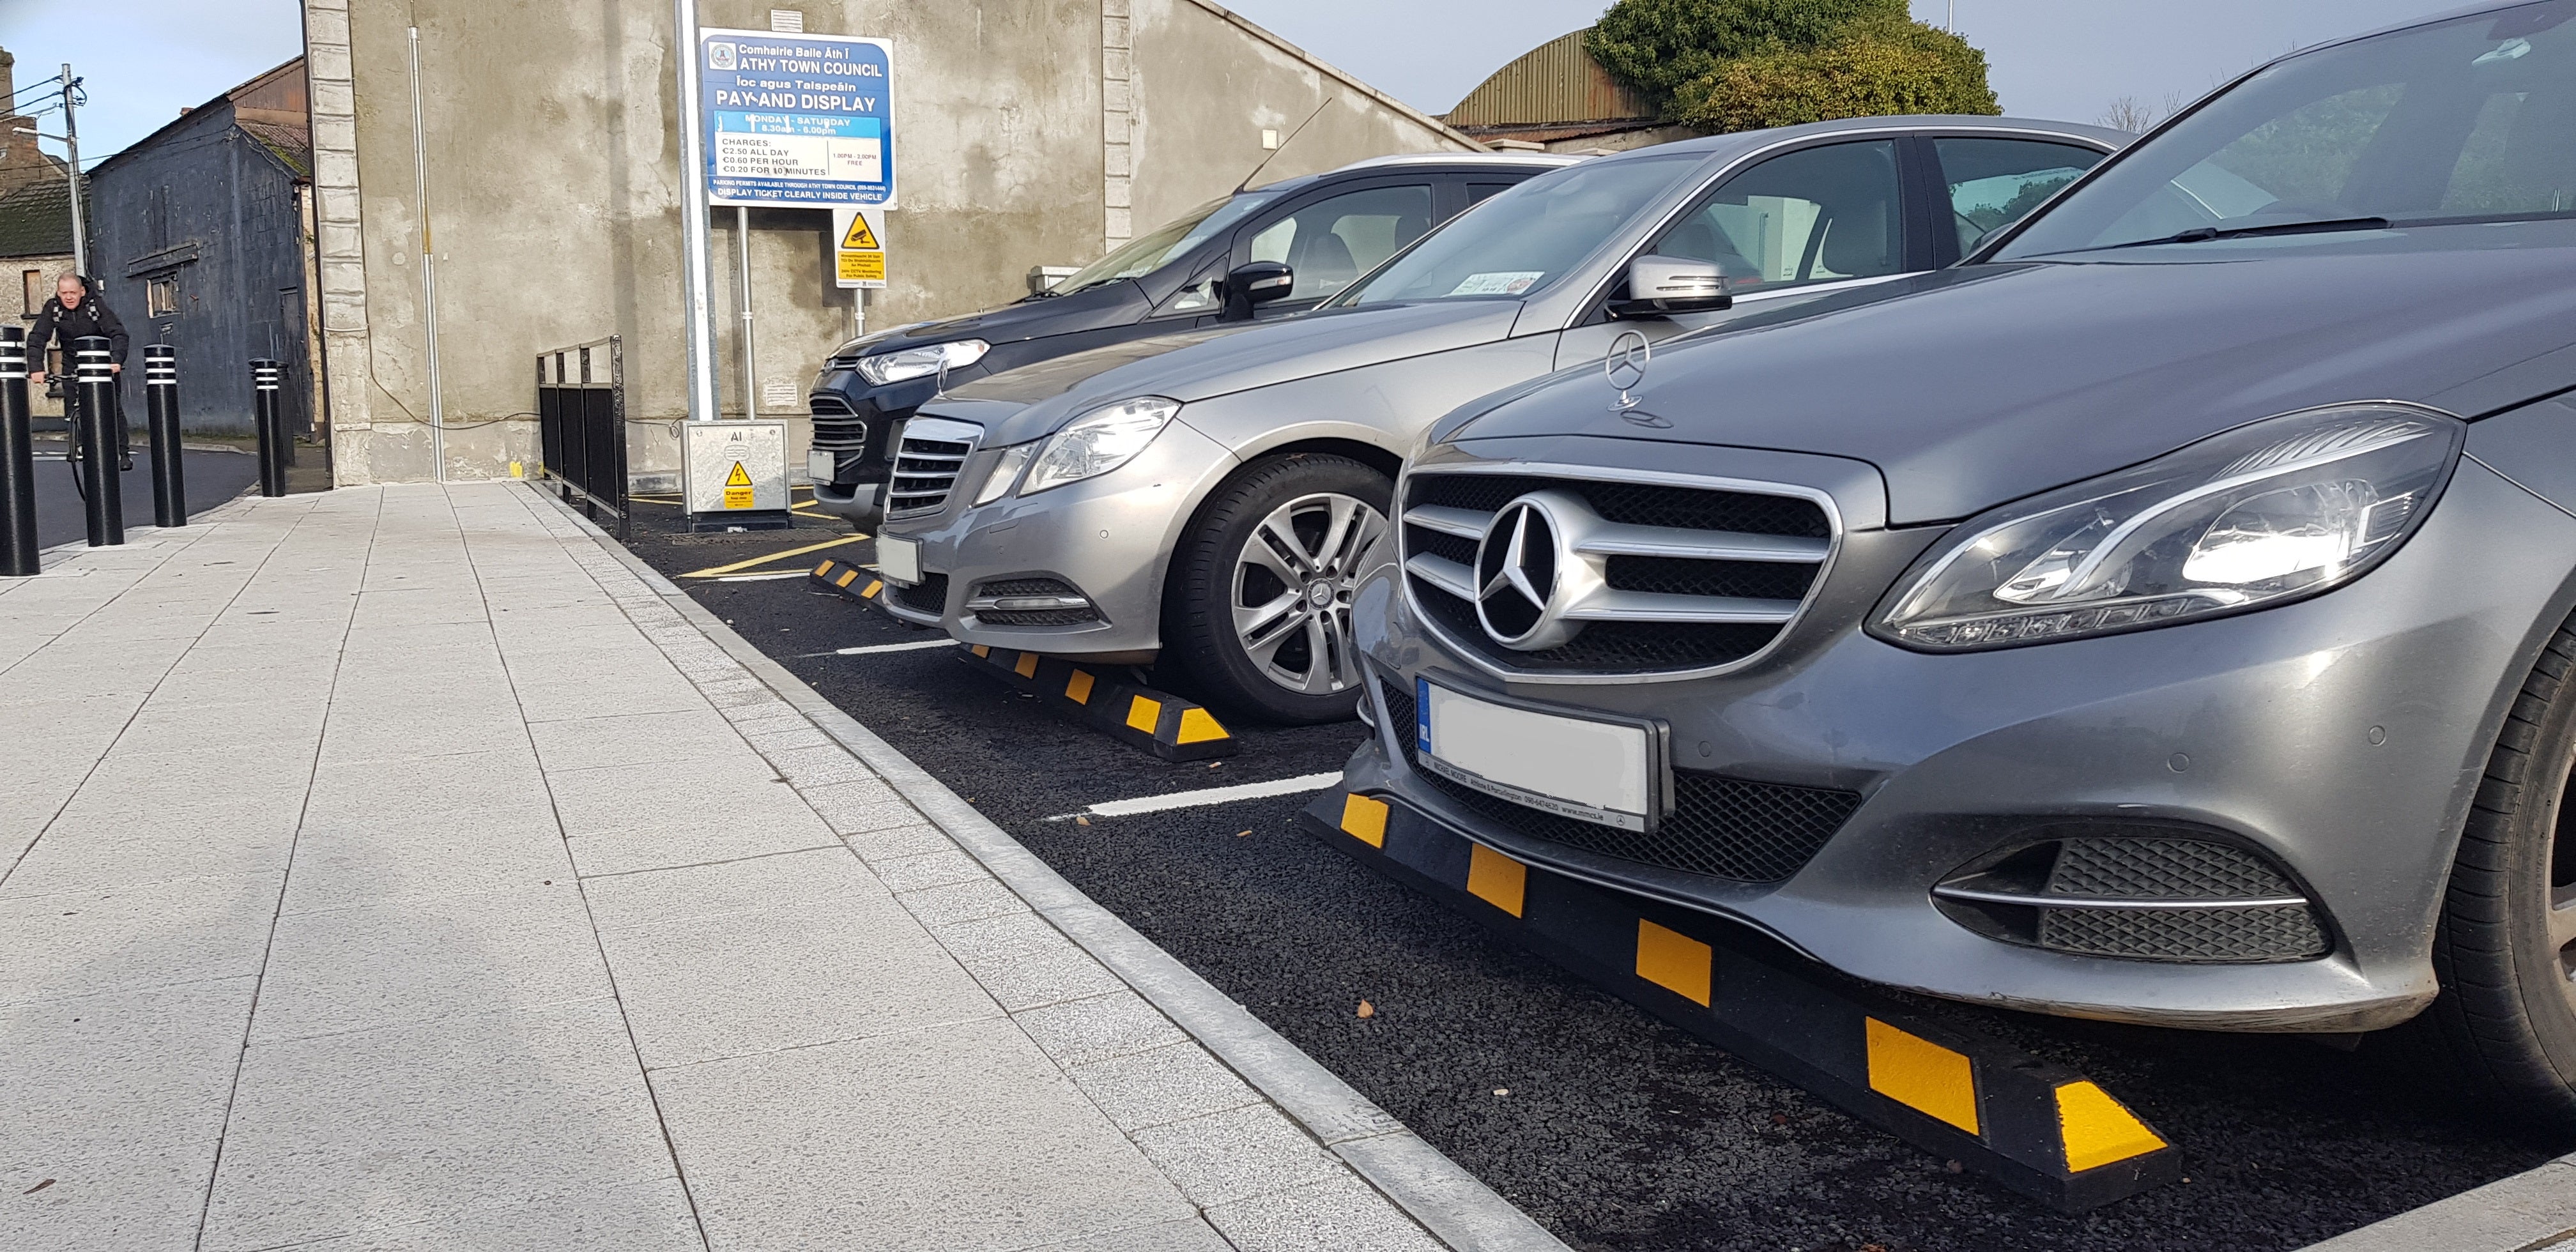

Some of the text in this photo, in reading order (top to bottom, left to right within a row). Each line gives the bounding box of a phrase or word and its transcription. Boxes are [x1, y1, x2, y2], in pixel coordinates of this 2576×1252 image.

[739, 44, 793, 56] Comhairle
[795, 47, 822, 57] Baile
[825, 47, 842, 59] Áth
[740, 57, 882, 77] ATHY TOWN COUNCIL
[760, 80, 792, 89] agus
[795, 80, 856, 92] Taispeáin
[716, 90, 875, 112] PAY AND DISPLAY
[745, 114, 788, 124] MONDAY
[797, 117, 850, 126] SATURDAY
[722, 138, 771, 147] CHARGES:
[718, 188, 752, 197] DISPLAY
[754, 189, 783, 198] TICKET
[785, 190, 821, 199] CLEARLY
[823, 192, 848, 200] INSIDE
[1419, 723, 1430, 742] IRL
